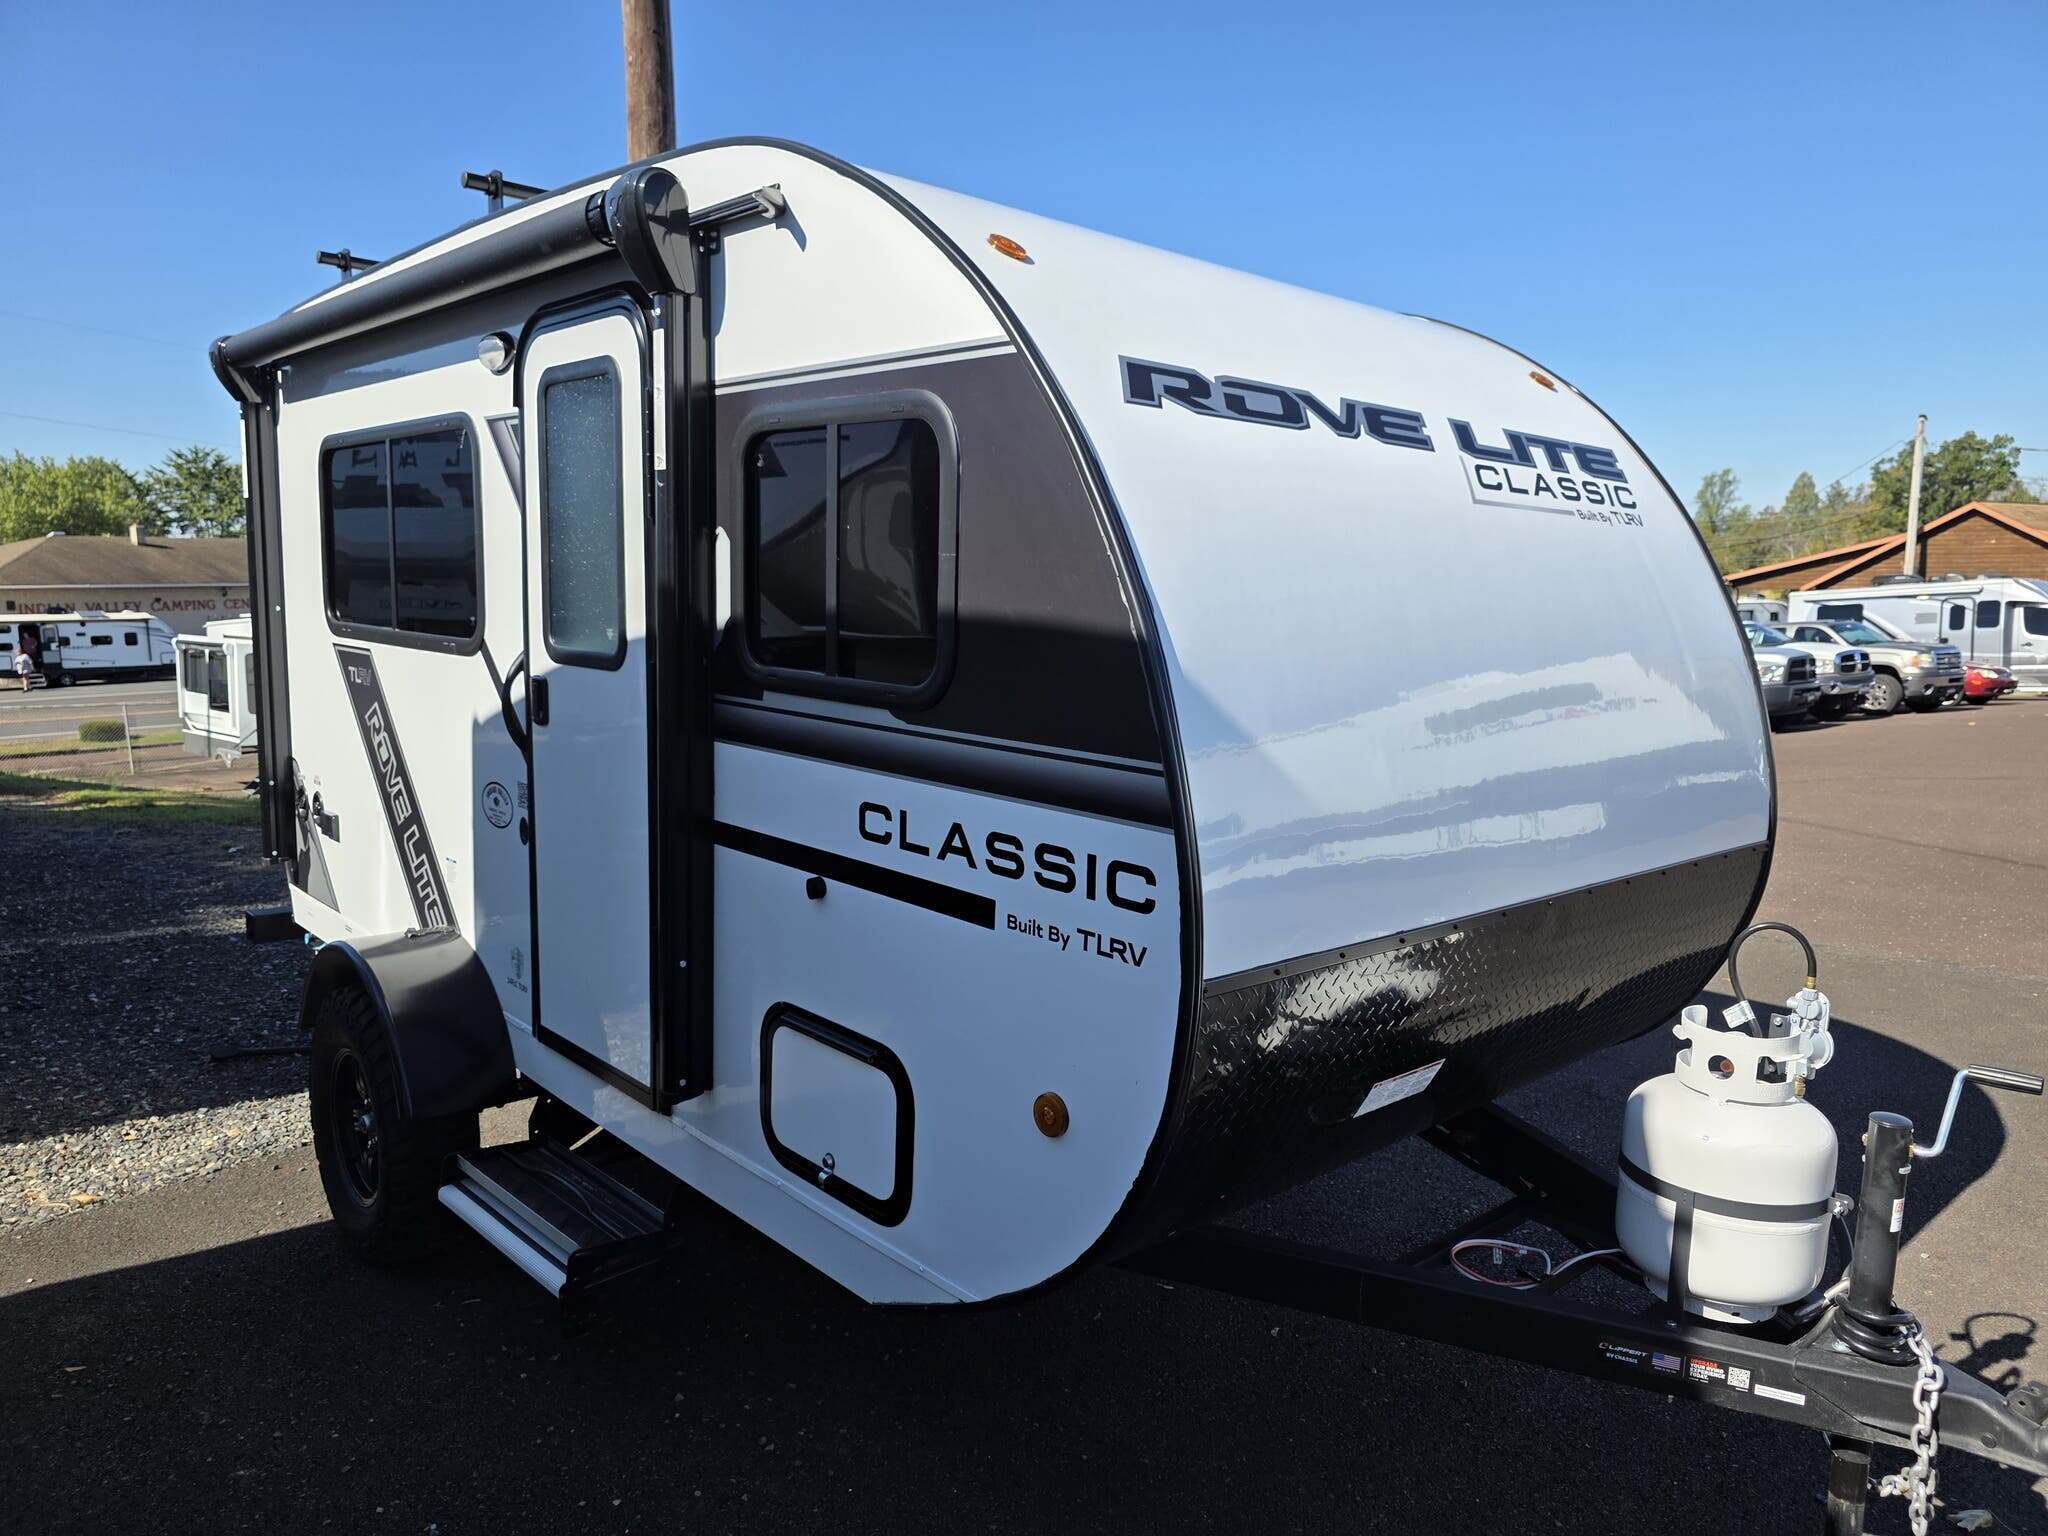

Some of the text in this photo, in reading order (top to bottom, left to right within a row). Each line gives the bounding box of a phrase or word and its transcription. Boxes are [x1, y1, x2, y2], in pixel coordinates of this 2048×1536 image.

[1119, 354, 1627, 483] ROVE LITE
[1475, 464, 1637, 509] CLASSIC
[1610, 510, 1644, 527] TLRV
[84, 601, 142, 612] VALLEY
[151, 599, 216, 612] CAMPING
[365, 702, 447, 929] ROVE LITE
[859, 801, 1157, 914] CLASSIC
[1007, 913, 1148, 967] Built By TLRV
